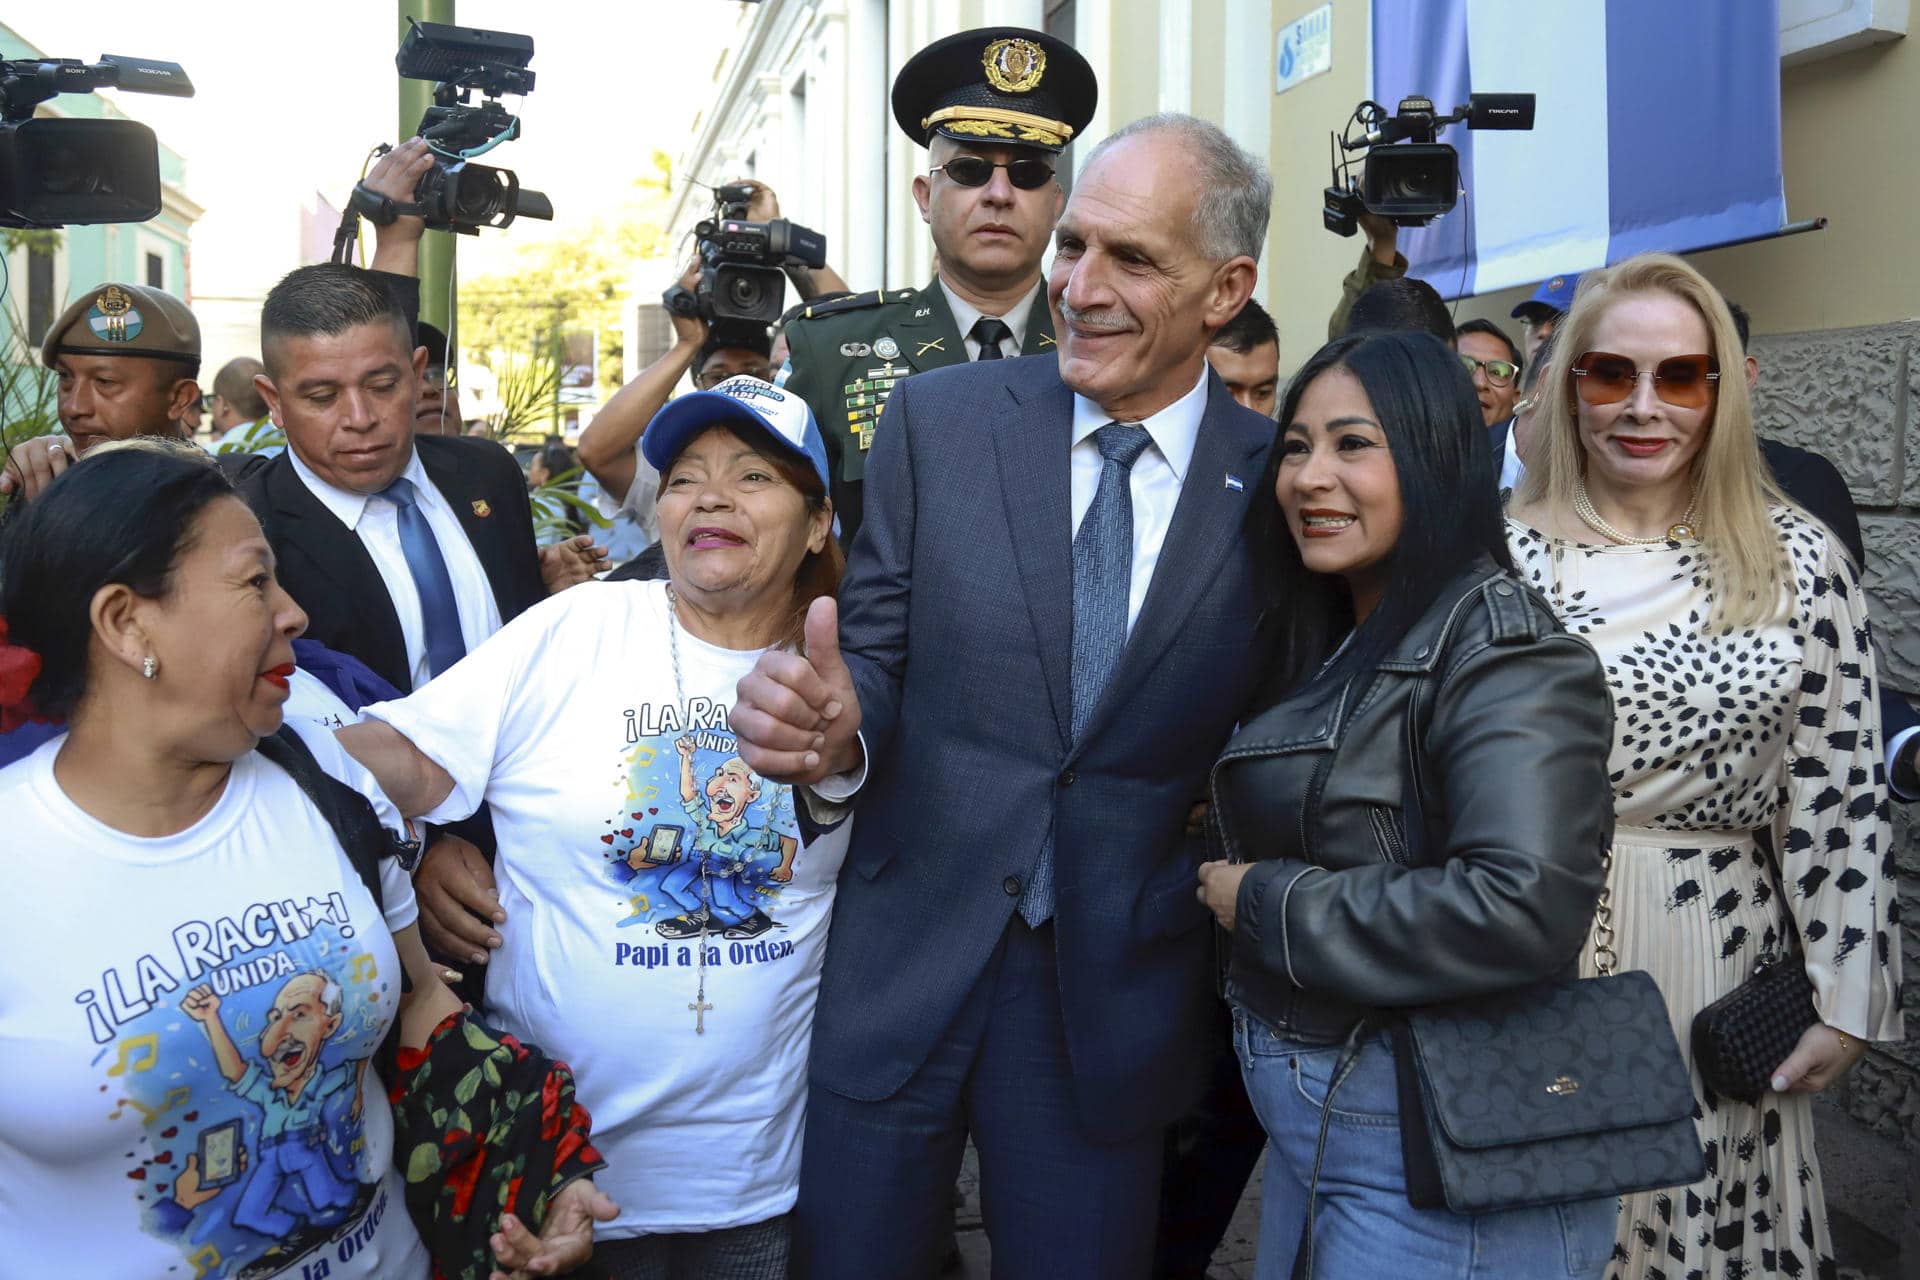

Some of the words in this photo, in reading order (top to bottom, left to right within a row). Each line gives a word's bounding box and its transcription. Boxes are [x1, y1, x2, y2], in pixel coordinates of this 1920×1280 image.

[738, 379, 771, 390] DIEGO
[740, 385, 784, 401] CAMBIO
[615, 942, 669, 969] Papi
[677, 946, 691, 966] a
[729, 940, 794, 966] Orden
[209, 951, 297, 997] UNIDA
[338, 1190, 389, 1263] Orden
